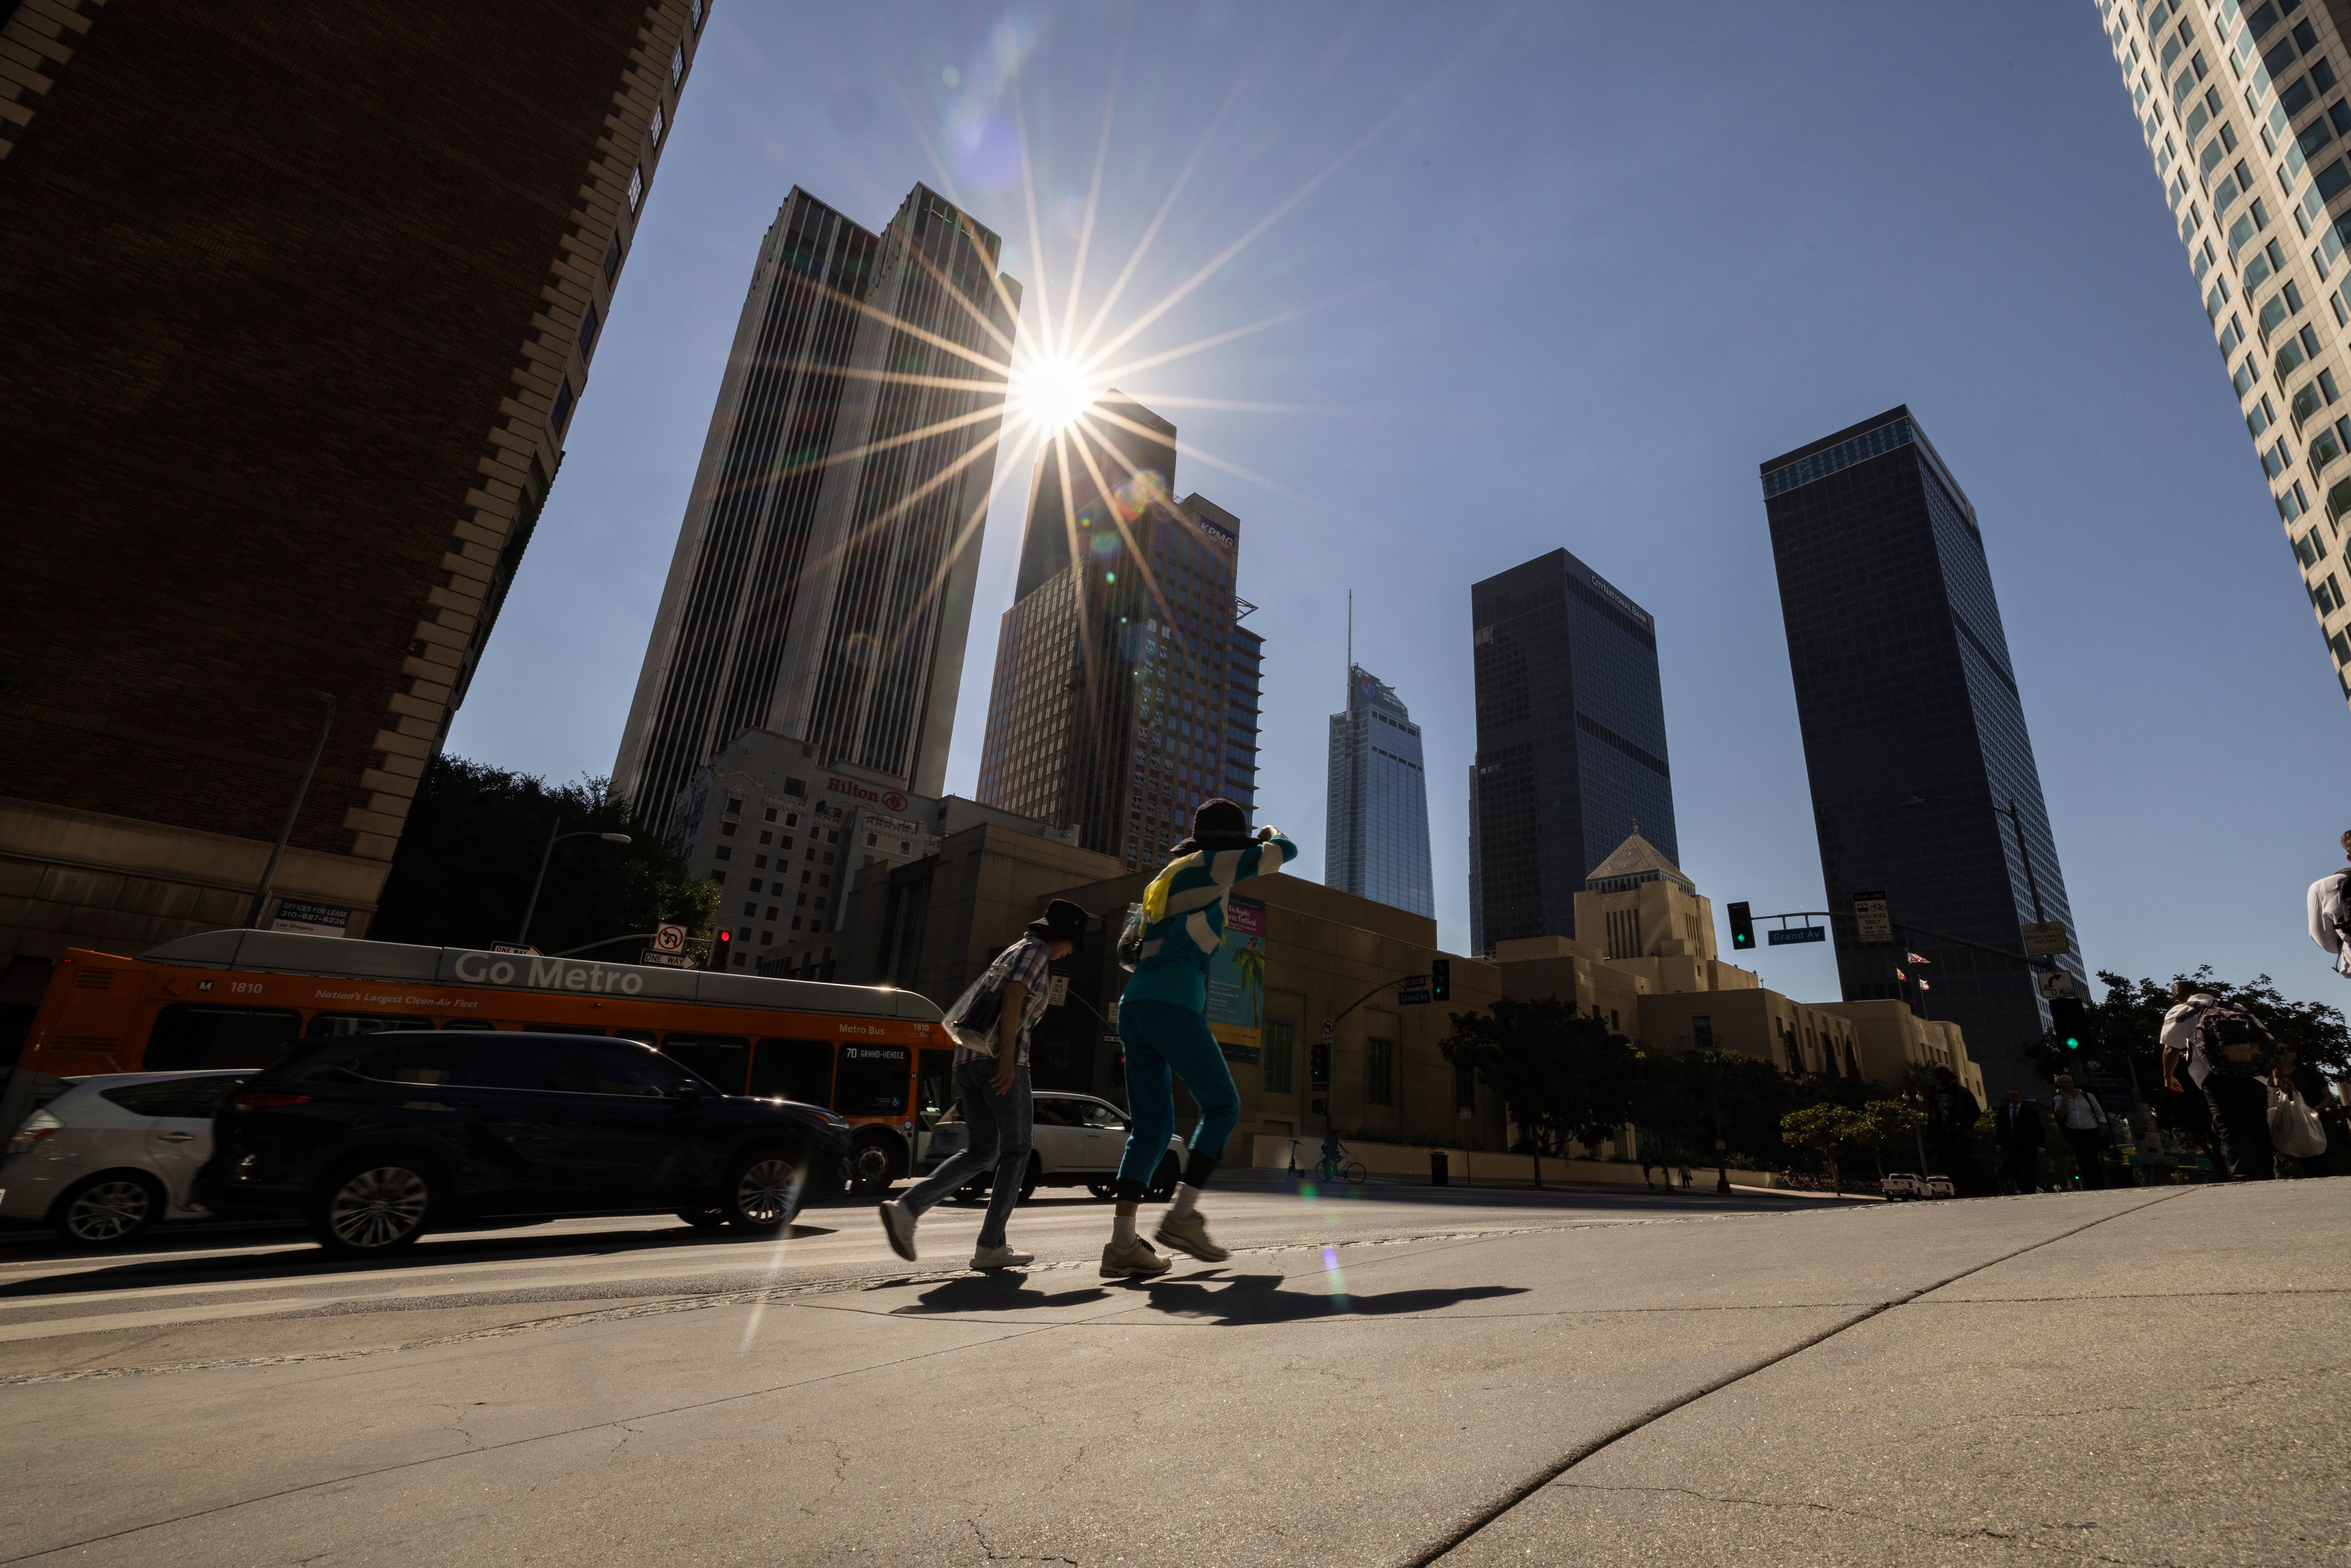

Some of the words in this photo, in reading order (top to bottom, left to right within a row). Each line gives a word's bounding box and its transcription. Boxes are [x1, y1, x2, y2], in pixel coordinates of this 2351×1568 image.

[1200, 522, 1233, 546] KPMG
[827, 777, 878, 802] Hilton
[284, 903, 312, 912] OFFICES
[1236, 908, 1250, 916] Angeles
[281, 910, 346, 925] 310-887-6226
[1238, 915, 1256, 926] Festival
[1773, 931, 1804, 941] Grand
[645, 953, 662, 963] ONE
[667, 956, 685, 965] WAY
[455, 952, 515, 985] Go
[527, 958, 643, 994] Metro
[198, 981, 213, 990] M
[230, 982, 262, 993] 1810
[316, 989, 361, 1000] Nation's
[364, 993, 402, 1004] Largest
[405, 996, 451, 1006] Clean-Air
[1401, 993, 1419, 1002] Grand
[839, 1024, 866, 1033] Metro
[869, 1026, 885, 1035] Bus
[847, 1048, 857, 1058] 70
[860, 1050, 904, 1059] GRAND-VENICE
